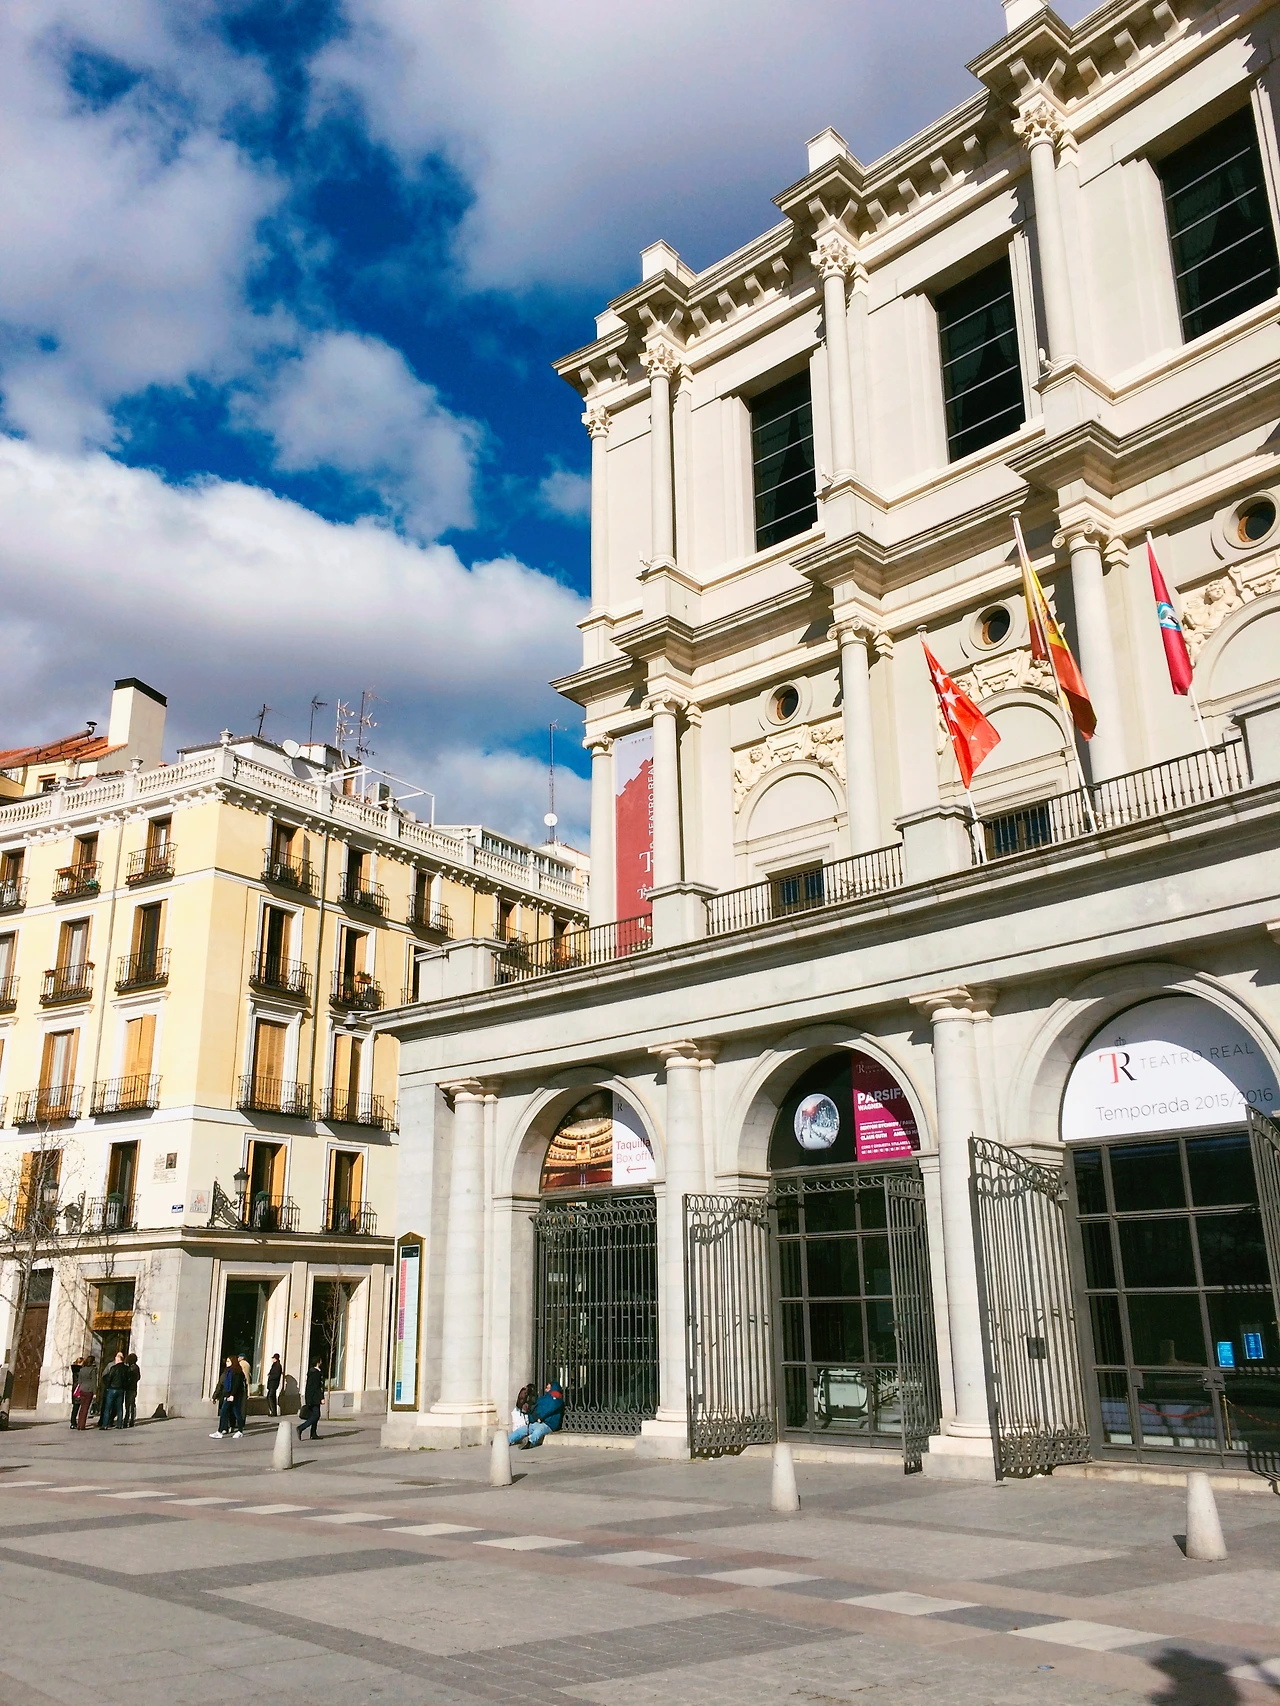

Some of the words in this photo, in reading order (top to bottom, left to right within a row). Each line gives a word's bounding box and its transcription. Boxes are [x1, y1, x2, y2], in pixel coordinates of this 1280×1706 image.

[1140, 1050, 1203, 1070] TEATRO
[1209, 1042, 1255, 1060] REAL
[857, 1102, 884, 1112] WAGNER
[1096, 1098, 1190, 1122] Temporada
[1195, 1087, 1274, 1111] 2015/2016
[616, 1138, 650, 1150] Taquilla
[616, 1153, 632, 1164] Box
